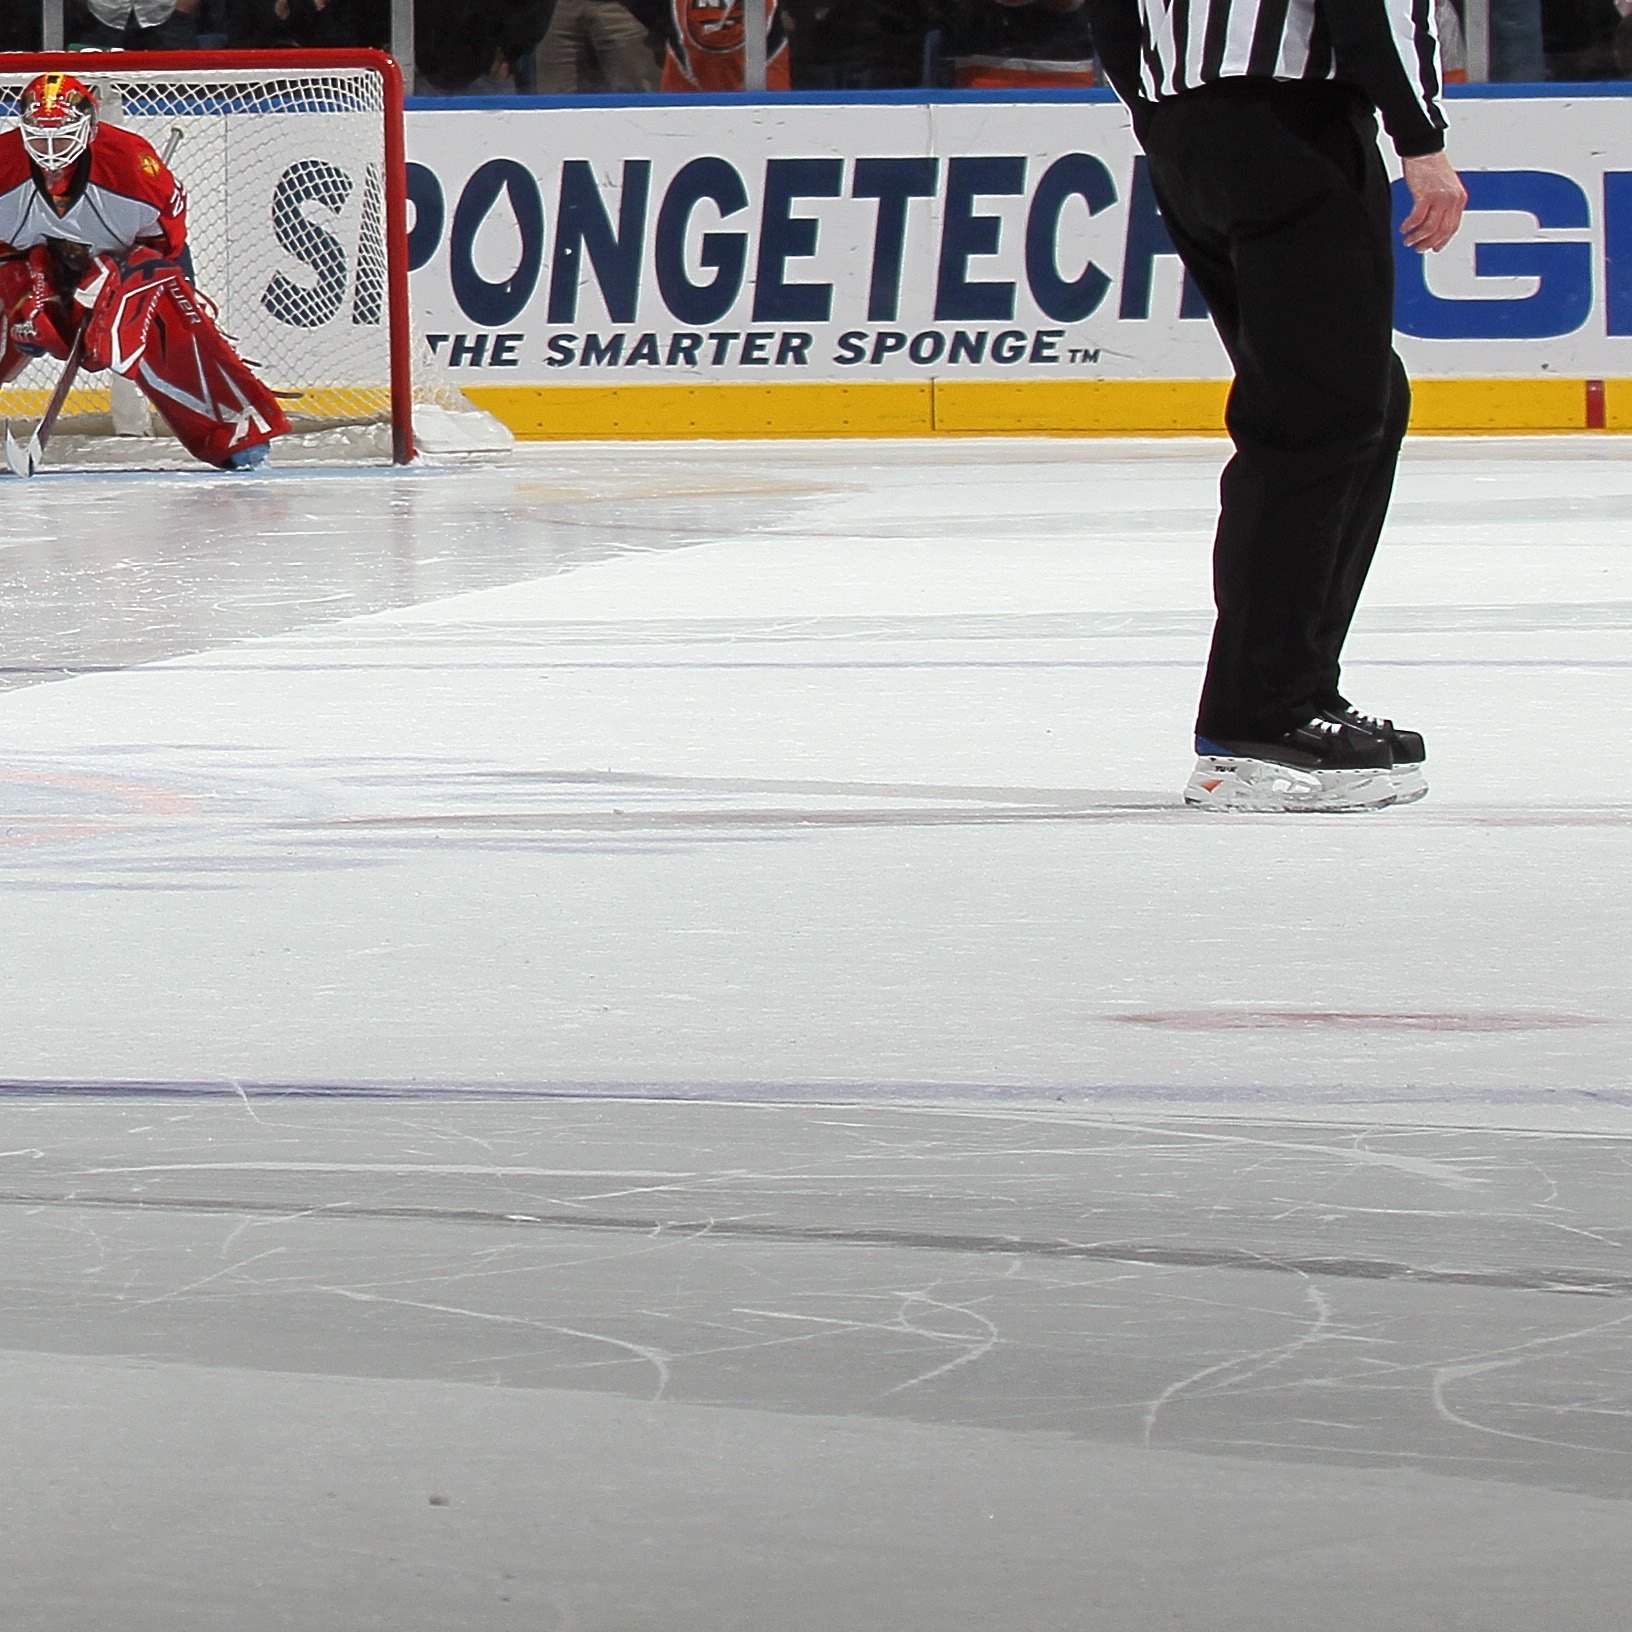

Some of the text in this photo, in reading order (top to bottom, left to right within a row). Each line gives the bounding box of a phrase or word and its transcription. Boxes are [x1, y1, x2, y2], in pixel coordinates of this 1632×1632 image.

[261, 152, 1216, 329] SPONGETECH
[426, 333, 524, 367] THE
[545, 329, 811, 368] SMARTER
[833, 328, 1061, 365] SPONGE
